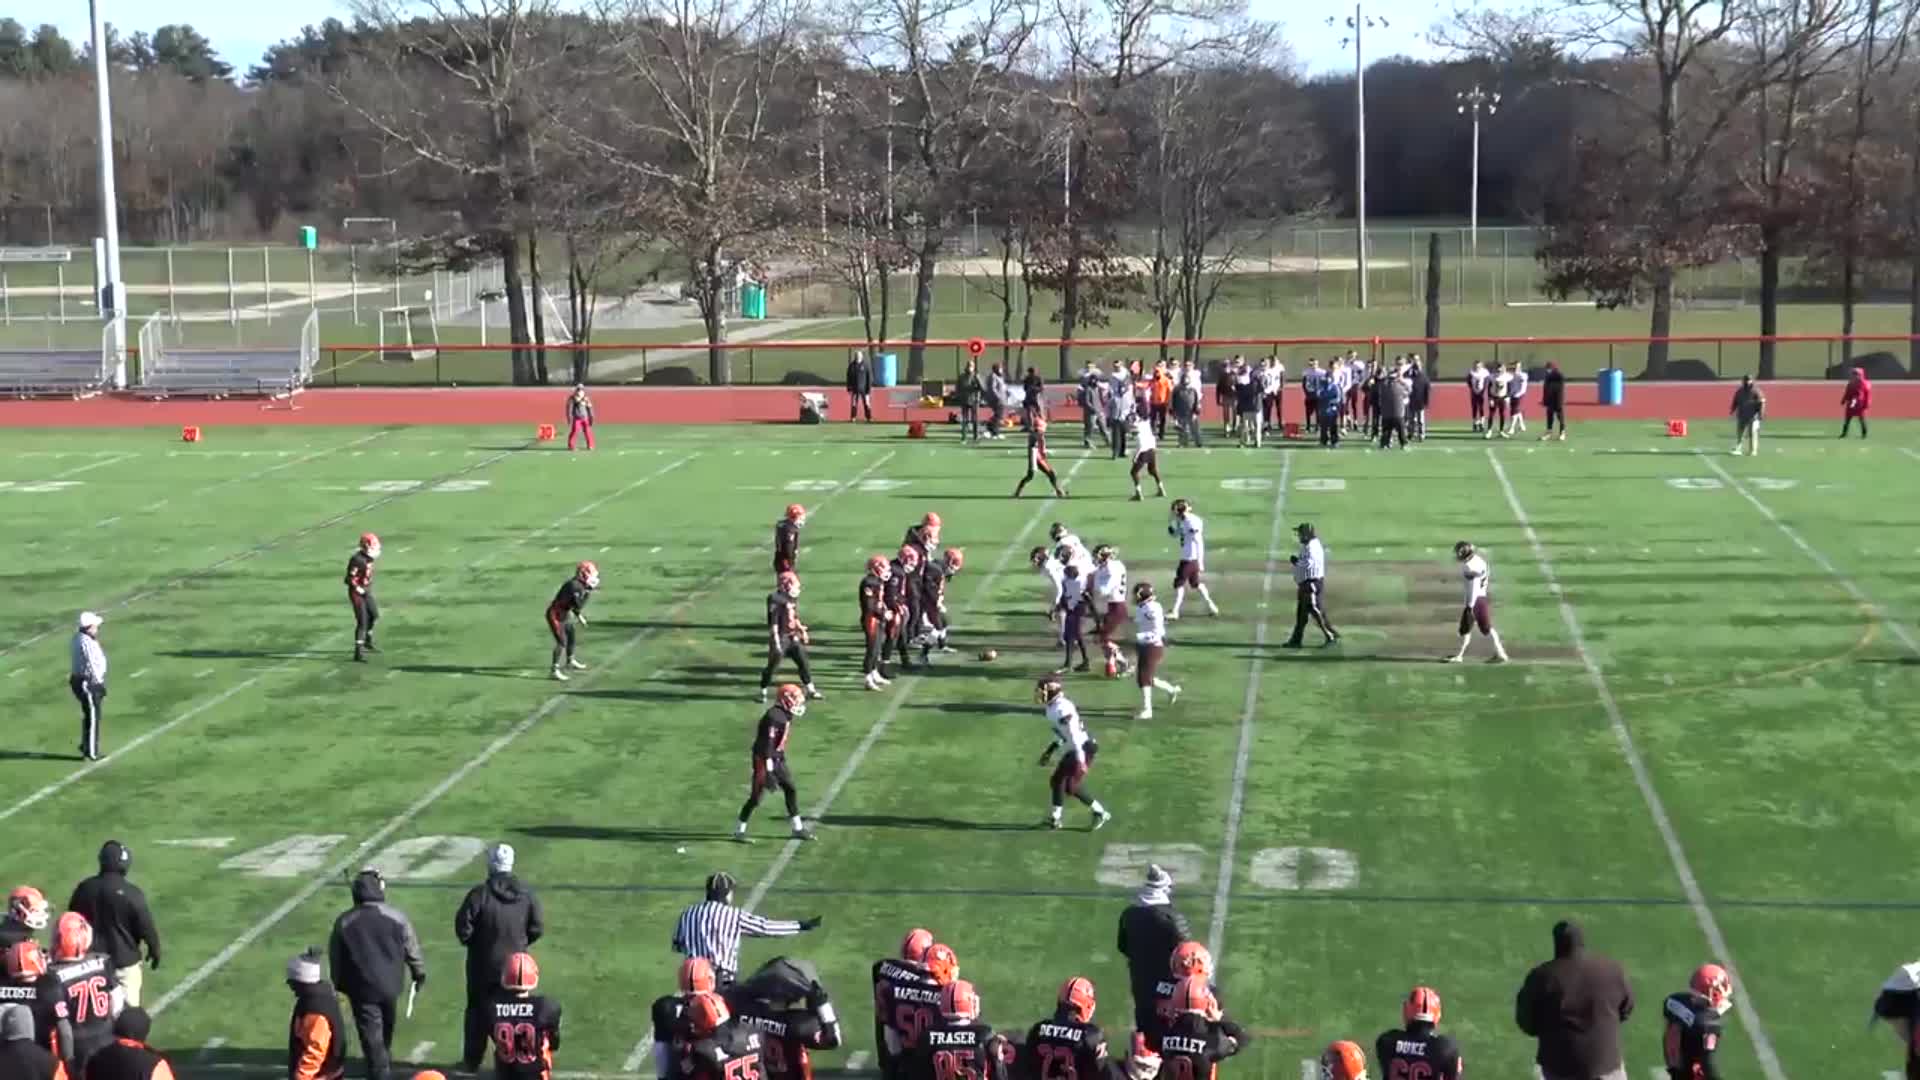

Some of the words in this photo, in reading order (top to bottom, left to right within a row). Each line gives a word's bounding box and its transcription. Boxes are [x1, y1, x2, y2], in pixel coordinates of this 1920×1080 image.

[68, 976, 109, 1023] 76
[495, 1003, 534, 1017] TOWER
[929, 1031, 976, 1046] FRASER
[1039, 1023, 1083, 1042] DEVEAU
[1162, 1035, 1207, 1055] KELLEY
[1395, 1040, 1428, 1056] DUKE
